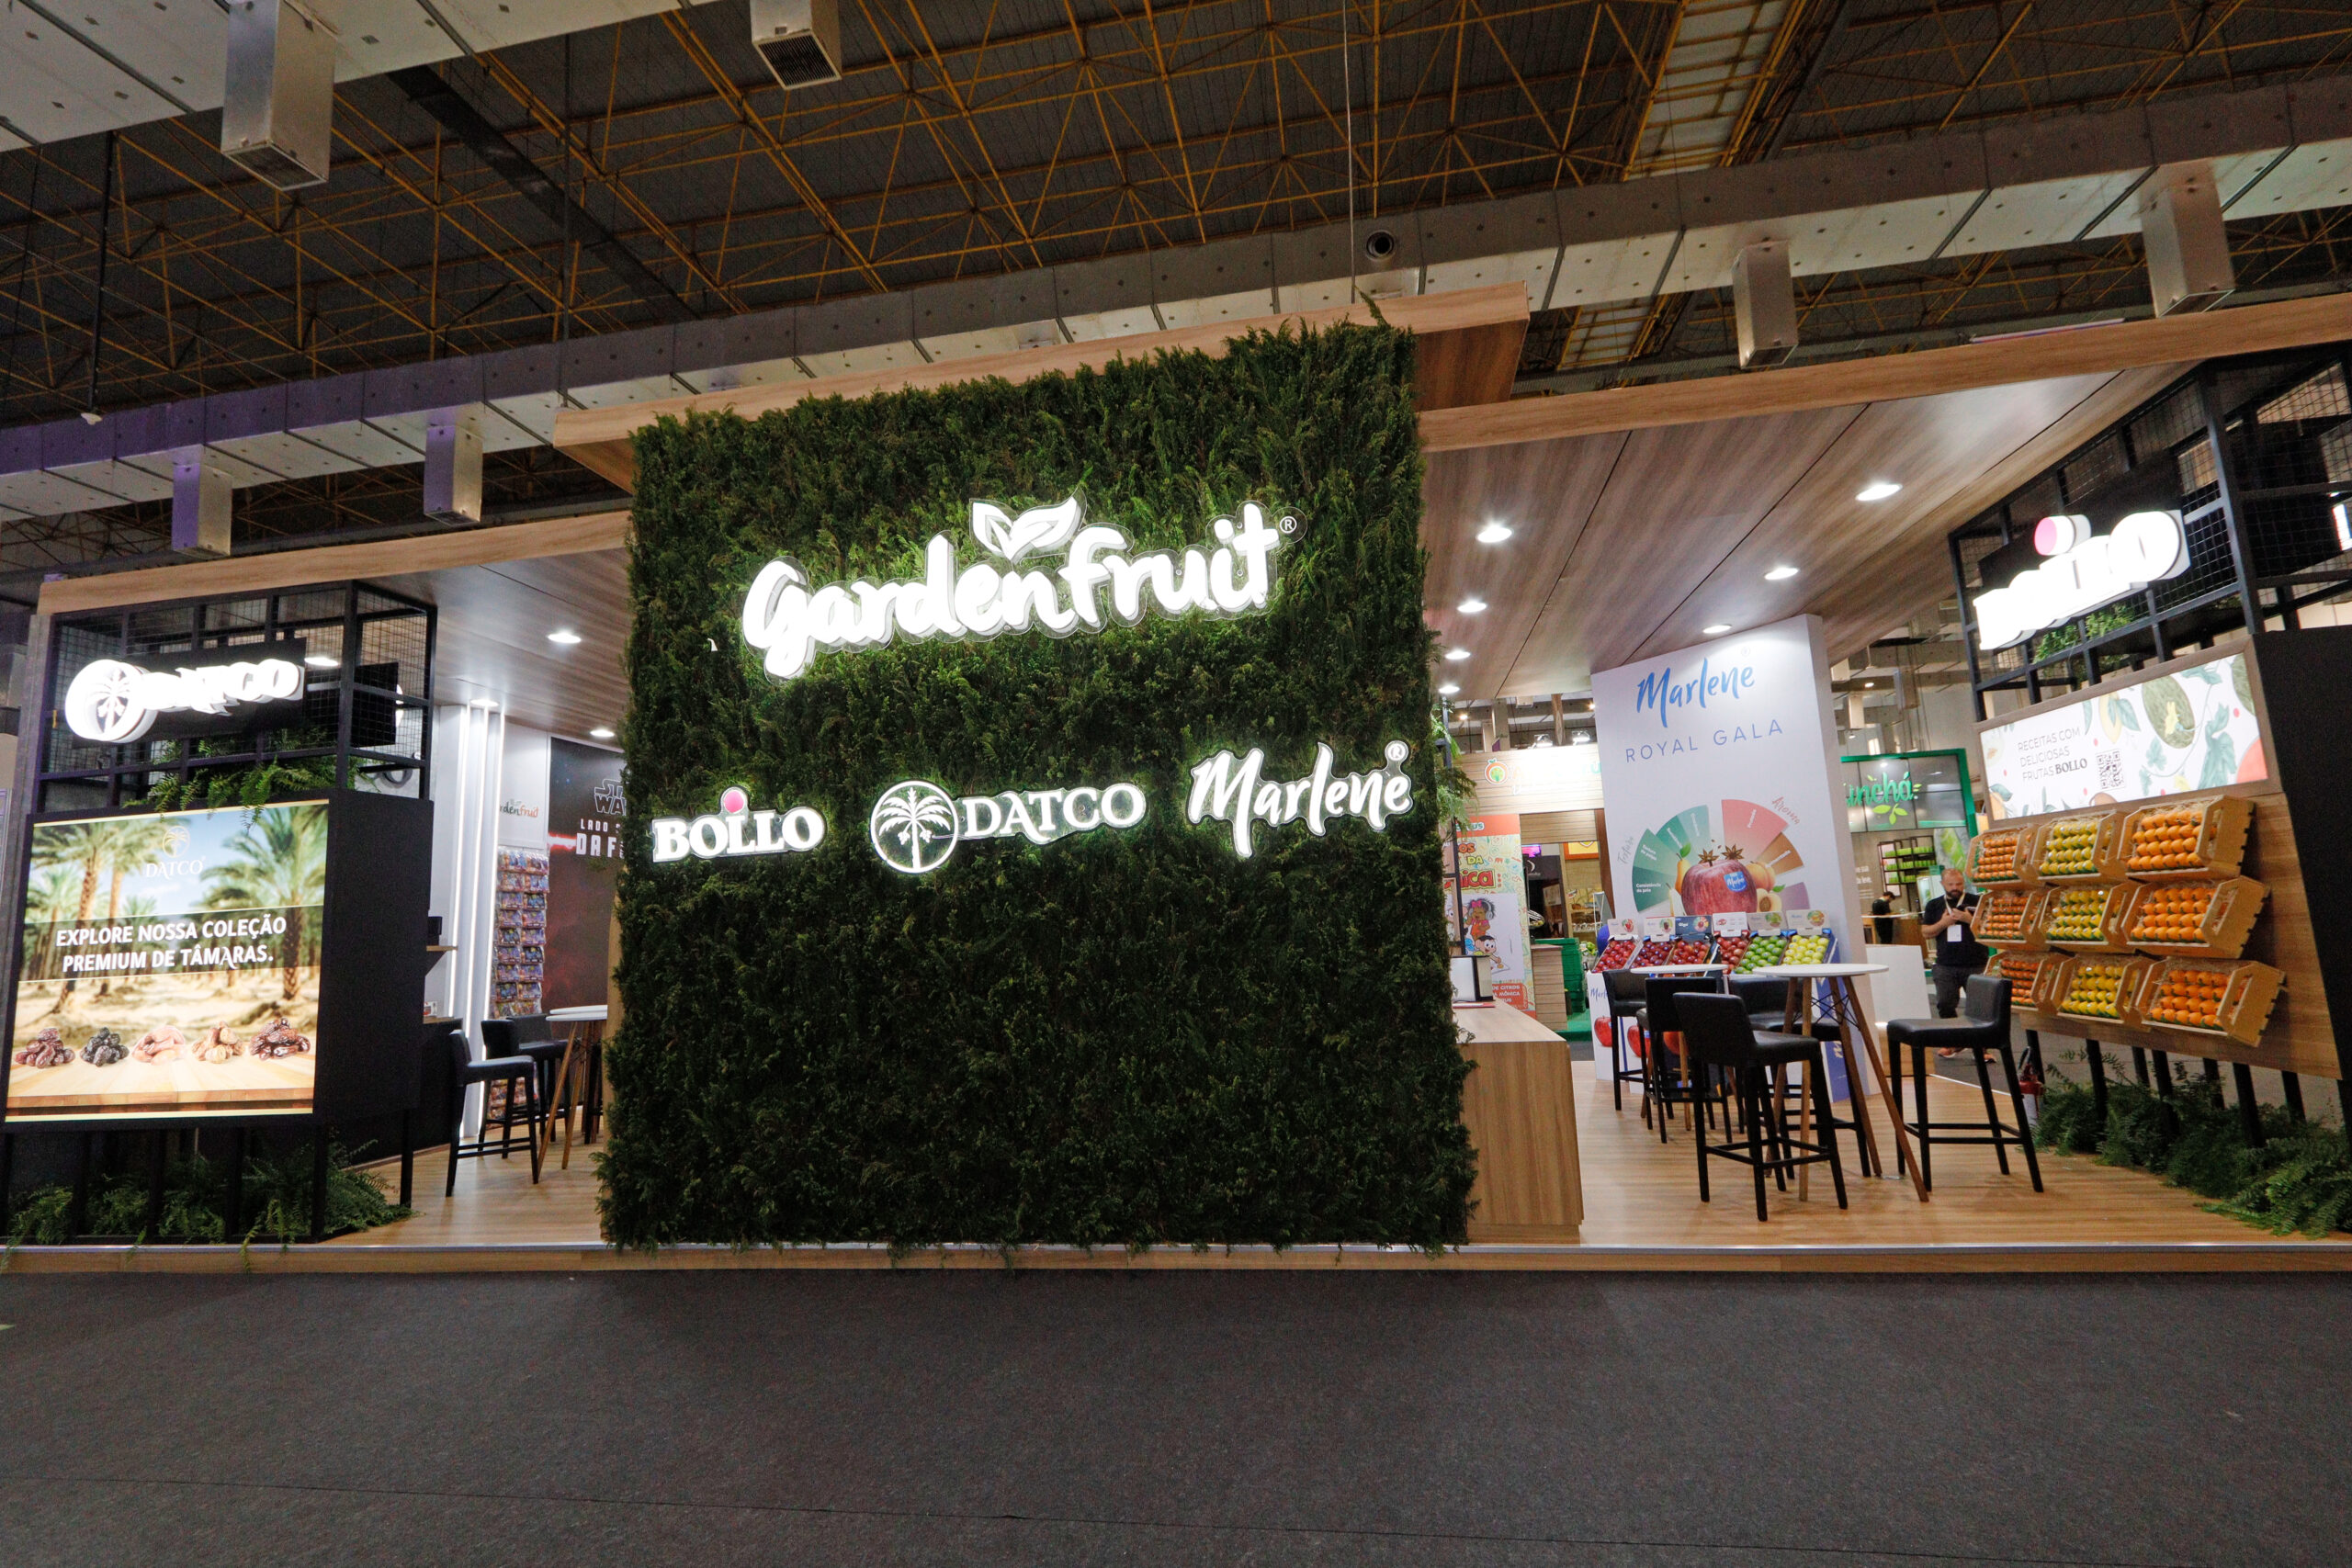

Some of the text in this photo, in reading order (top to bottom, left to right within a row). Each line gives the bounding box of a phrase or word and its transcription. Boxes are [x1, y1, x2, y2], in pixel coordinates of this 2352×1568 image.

[1636, 657, 1756, 728] Marlene
[1625, 719, 1783, 763] ROYAL GALA
[2018, 727, 2081, 751] RECEITAS COM
[2019, 746, 2071, 767] DELICIOSAS
[2022, 758, 2088, 782] FRUTAS BOLLO
[1189, 742, 1411, 857] Marlene
[580, 818, 608, 832] LADO
[963, 785, 1145, 844] DATCO
[653, 805, 824, 862] BOLLO
[145, 859, 204, 880] DATCO
[1467, 855, 1484, 865] DA
[56, 914, 287, 947] EXPLORE NOSSA COLEÇÃO
[62, 944, 274, 973] PREMIUM DE TÂMARAS.
